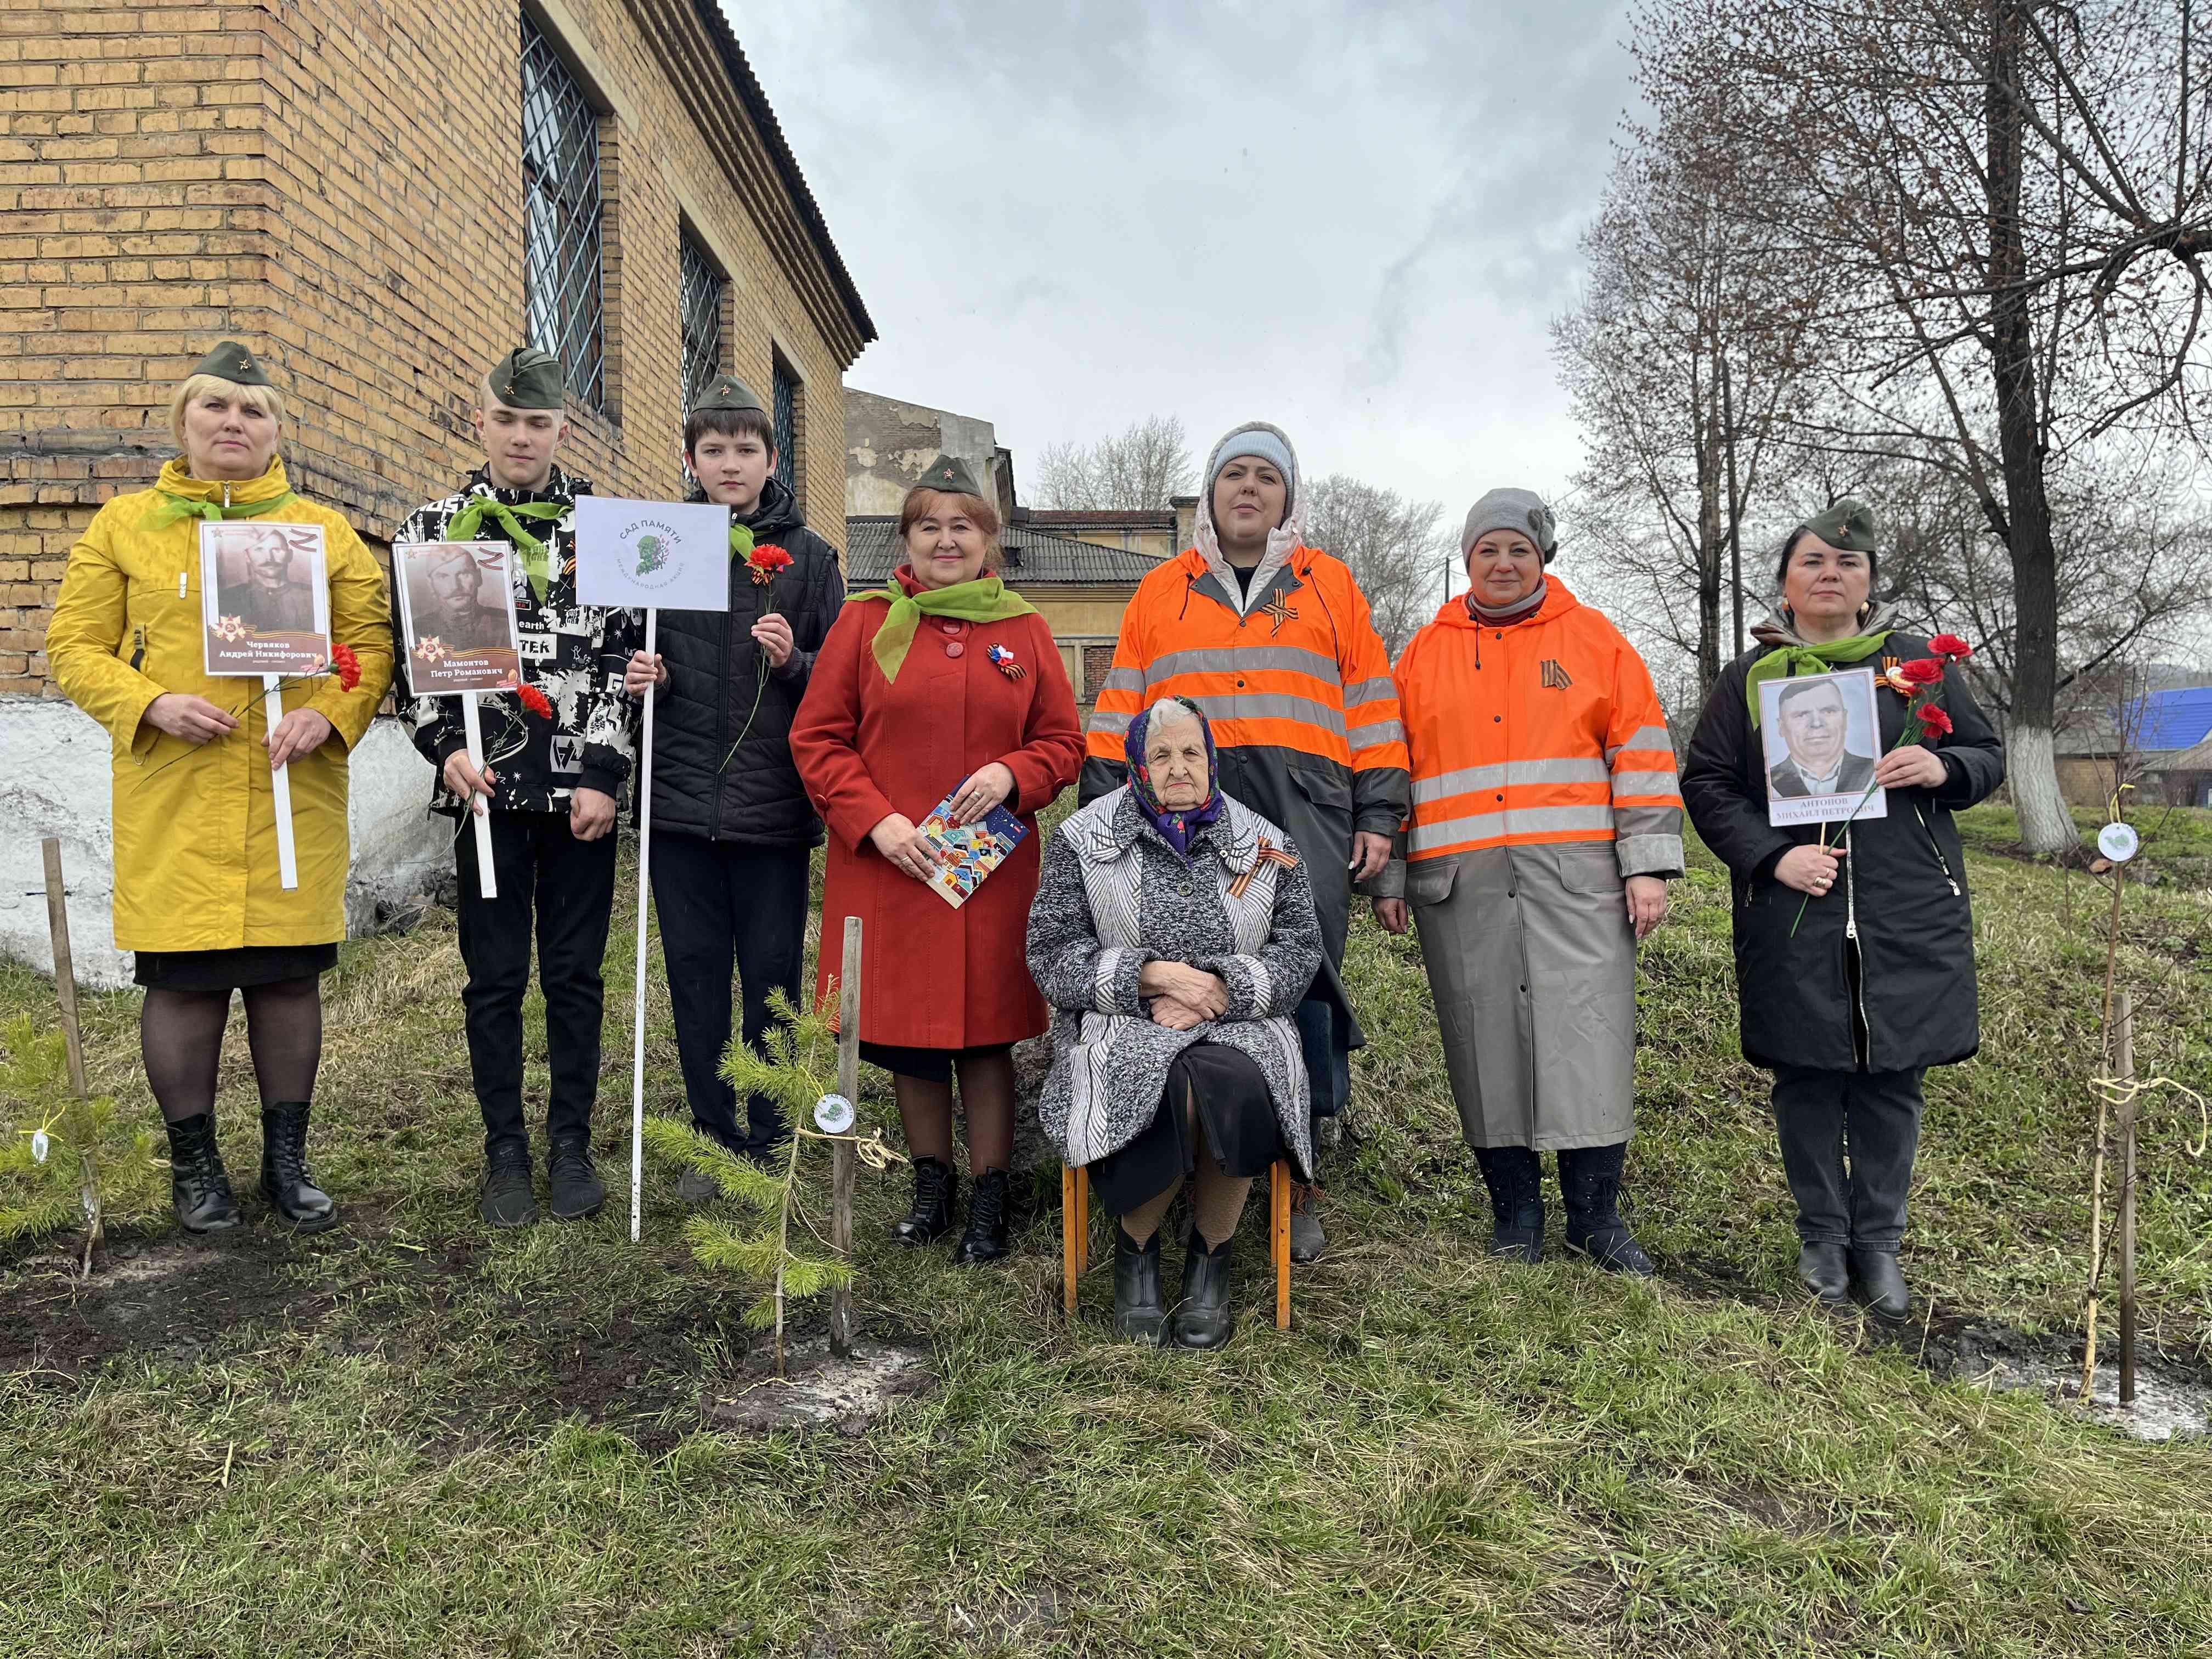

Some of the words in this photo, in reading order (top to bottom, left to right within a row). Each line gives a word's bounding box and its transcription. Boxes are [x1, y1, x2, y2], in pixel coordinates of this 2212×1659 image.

[620, 522, 639, 539] САД
[641, 520, 682, 544] ПАМЯТИ
[617, 558, 668, 590] МЕЖДУНАРОДНАЯ
[670, 562, 685, 583] АКЦИЯ
[518, 620, 545, 630] earth
[246, 641, 290, 649] Червяков
[219, 650, 253, 659] Андрей
[255, 651, 317, 659] Никифорович
[443, 659, 489, 668] Мамонтов
[430, 670, 453, 679] Петр
[454, 668, 503, 676] Романович
[1801, 798, 1848, 808] АНТОНОВ
[1777, 809, 1820, 820] МИХАИЛ
